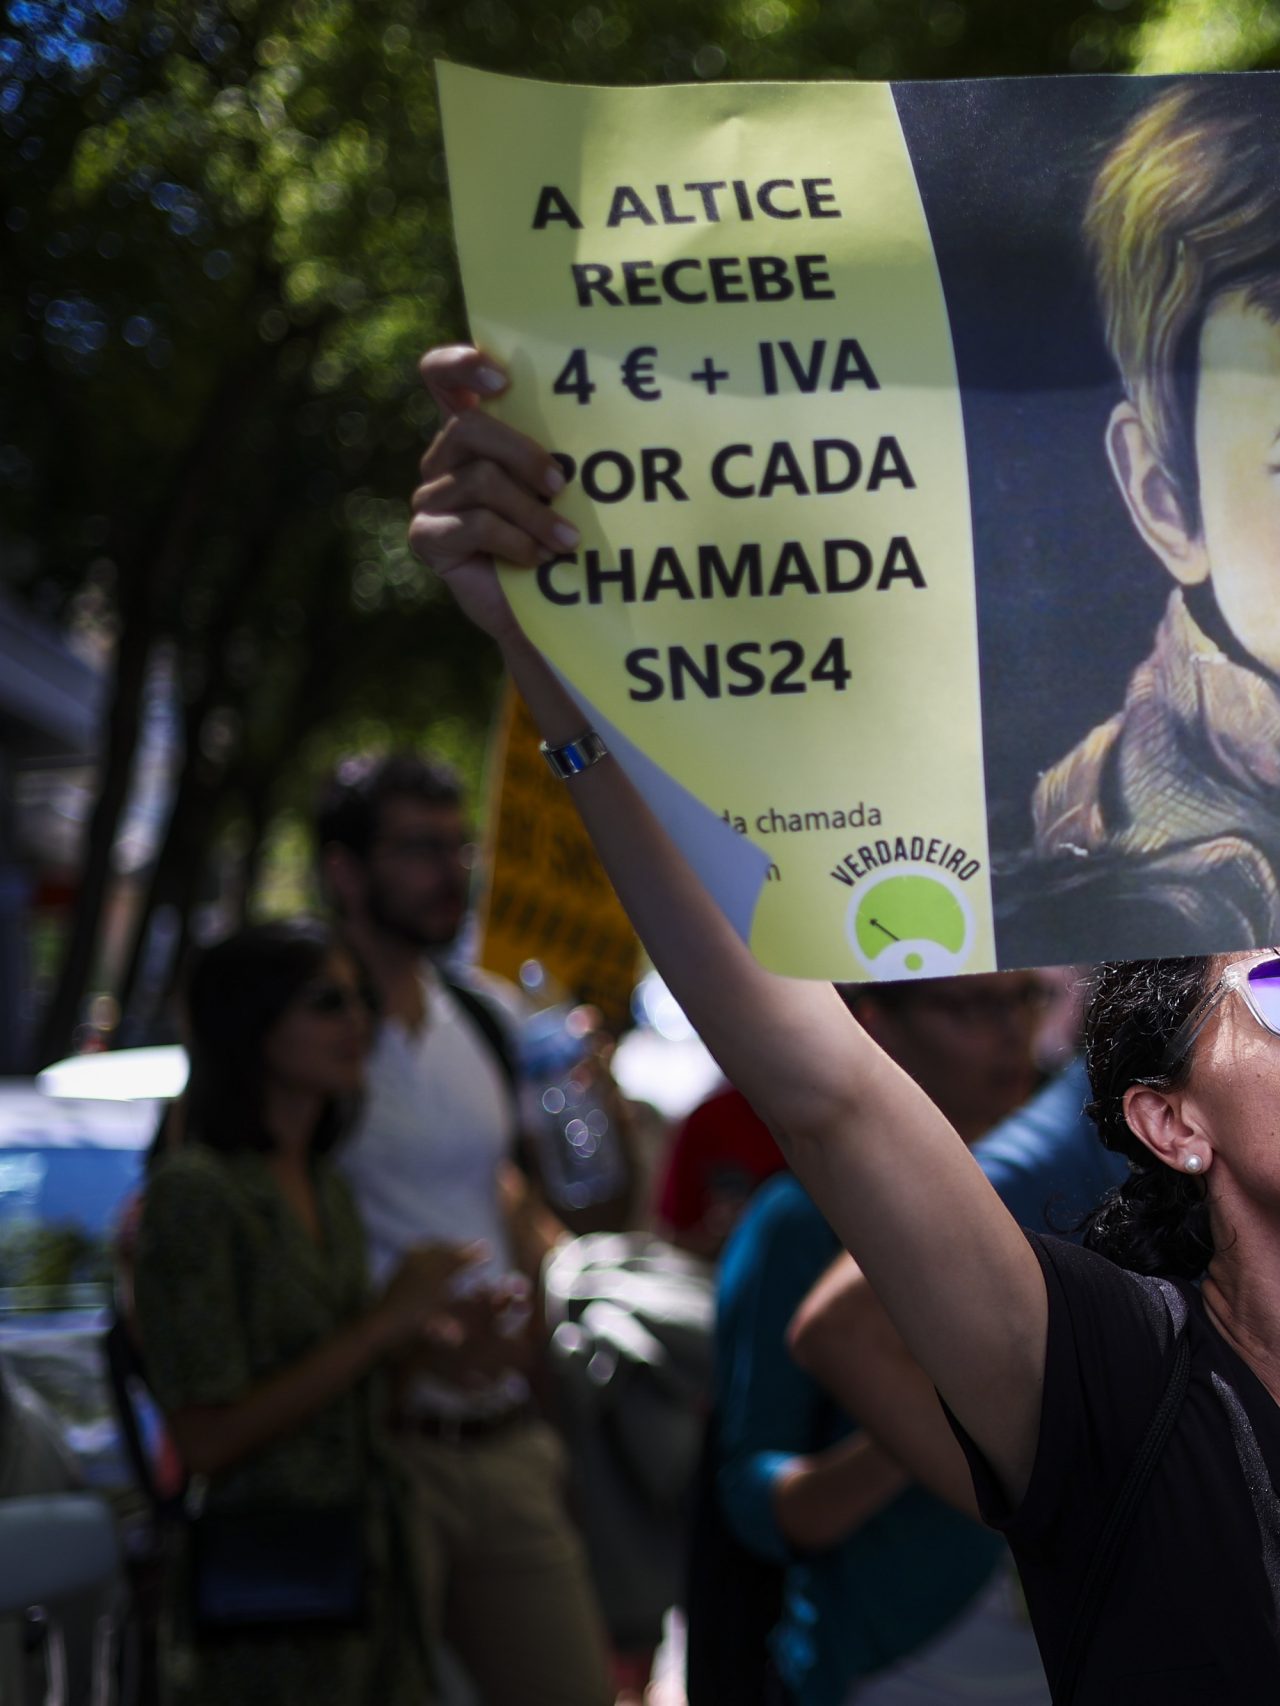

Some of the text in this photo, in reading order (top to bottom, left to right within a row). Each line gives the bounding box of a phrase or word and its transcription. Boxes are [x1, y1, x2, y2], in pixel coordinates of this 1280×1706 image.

[533, 178, 841, 230] A ALTICE
[572, 254, 836, 307] RECEBE
[553, 339, 880, 405] 4 € + IVA
[711, 435, 917, 498] CADA
[536, 536, 927, 606] CHAMADA
[624, 637, 852, 702] SNS24
[756, 802, 882, 834] chamada
[830, 837, 981, 887] VERDADEIRO
